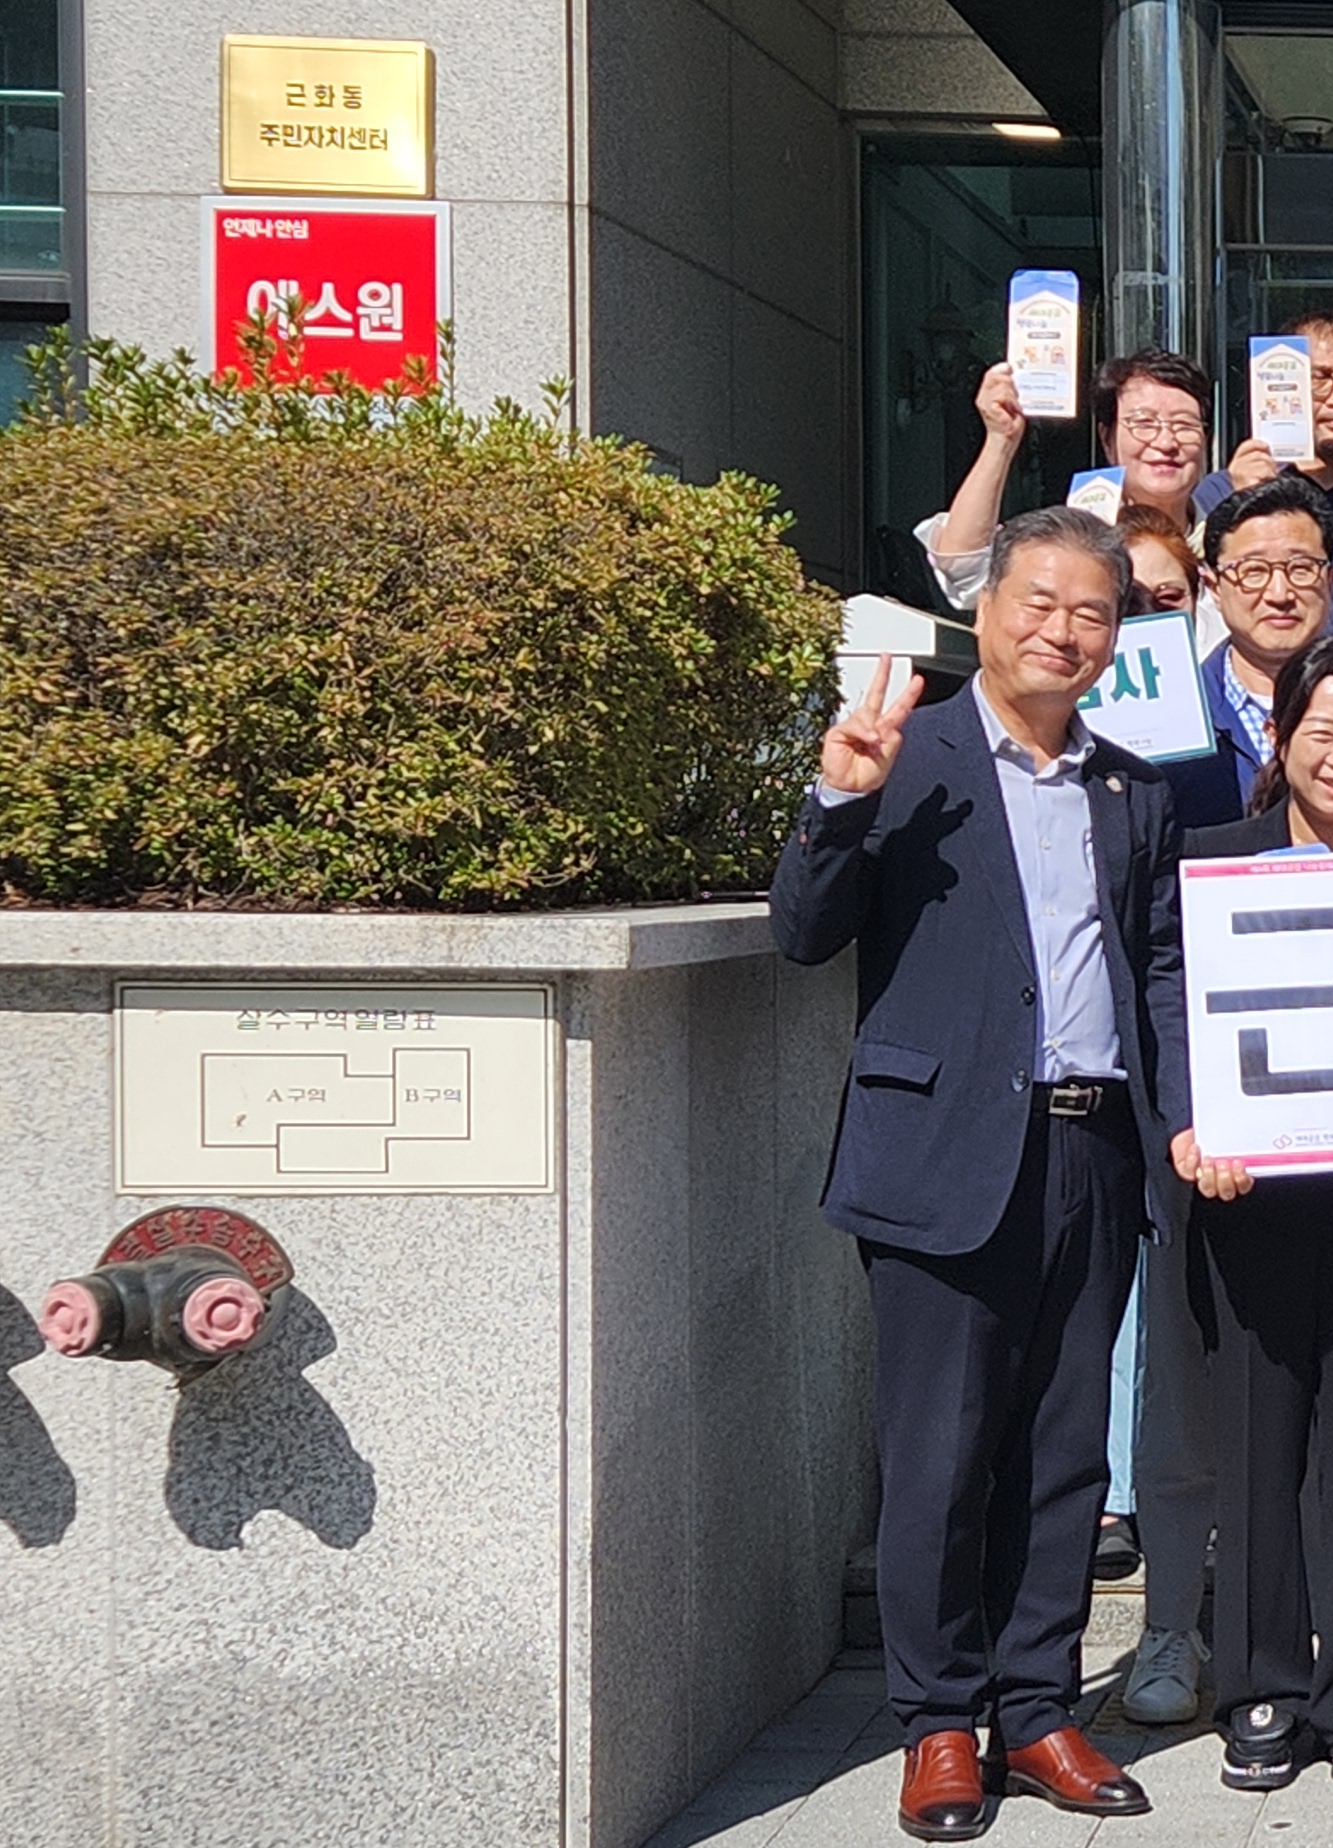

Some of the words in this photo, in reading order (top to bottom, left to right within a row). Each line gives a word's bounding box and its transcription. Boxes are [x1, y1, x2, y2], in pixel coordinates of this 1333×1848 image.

[259, 122, 388, 151] 주민자치센터
[222, 218, 273, 238] 언제나
[275, 219, 309, 239] 안심
[246, 278, 404, 342] 에스원
